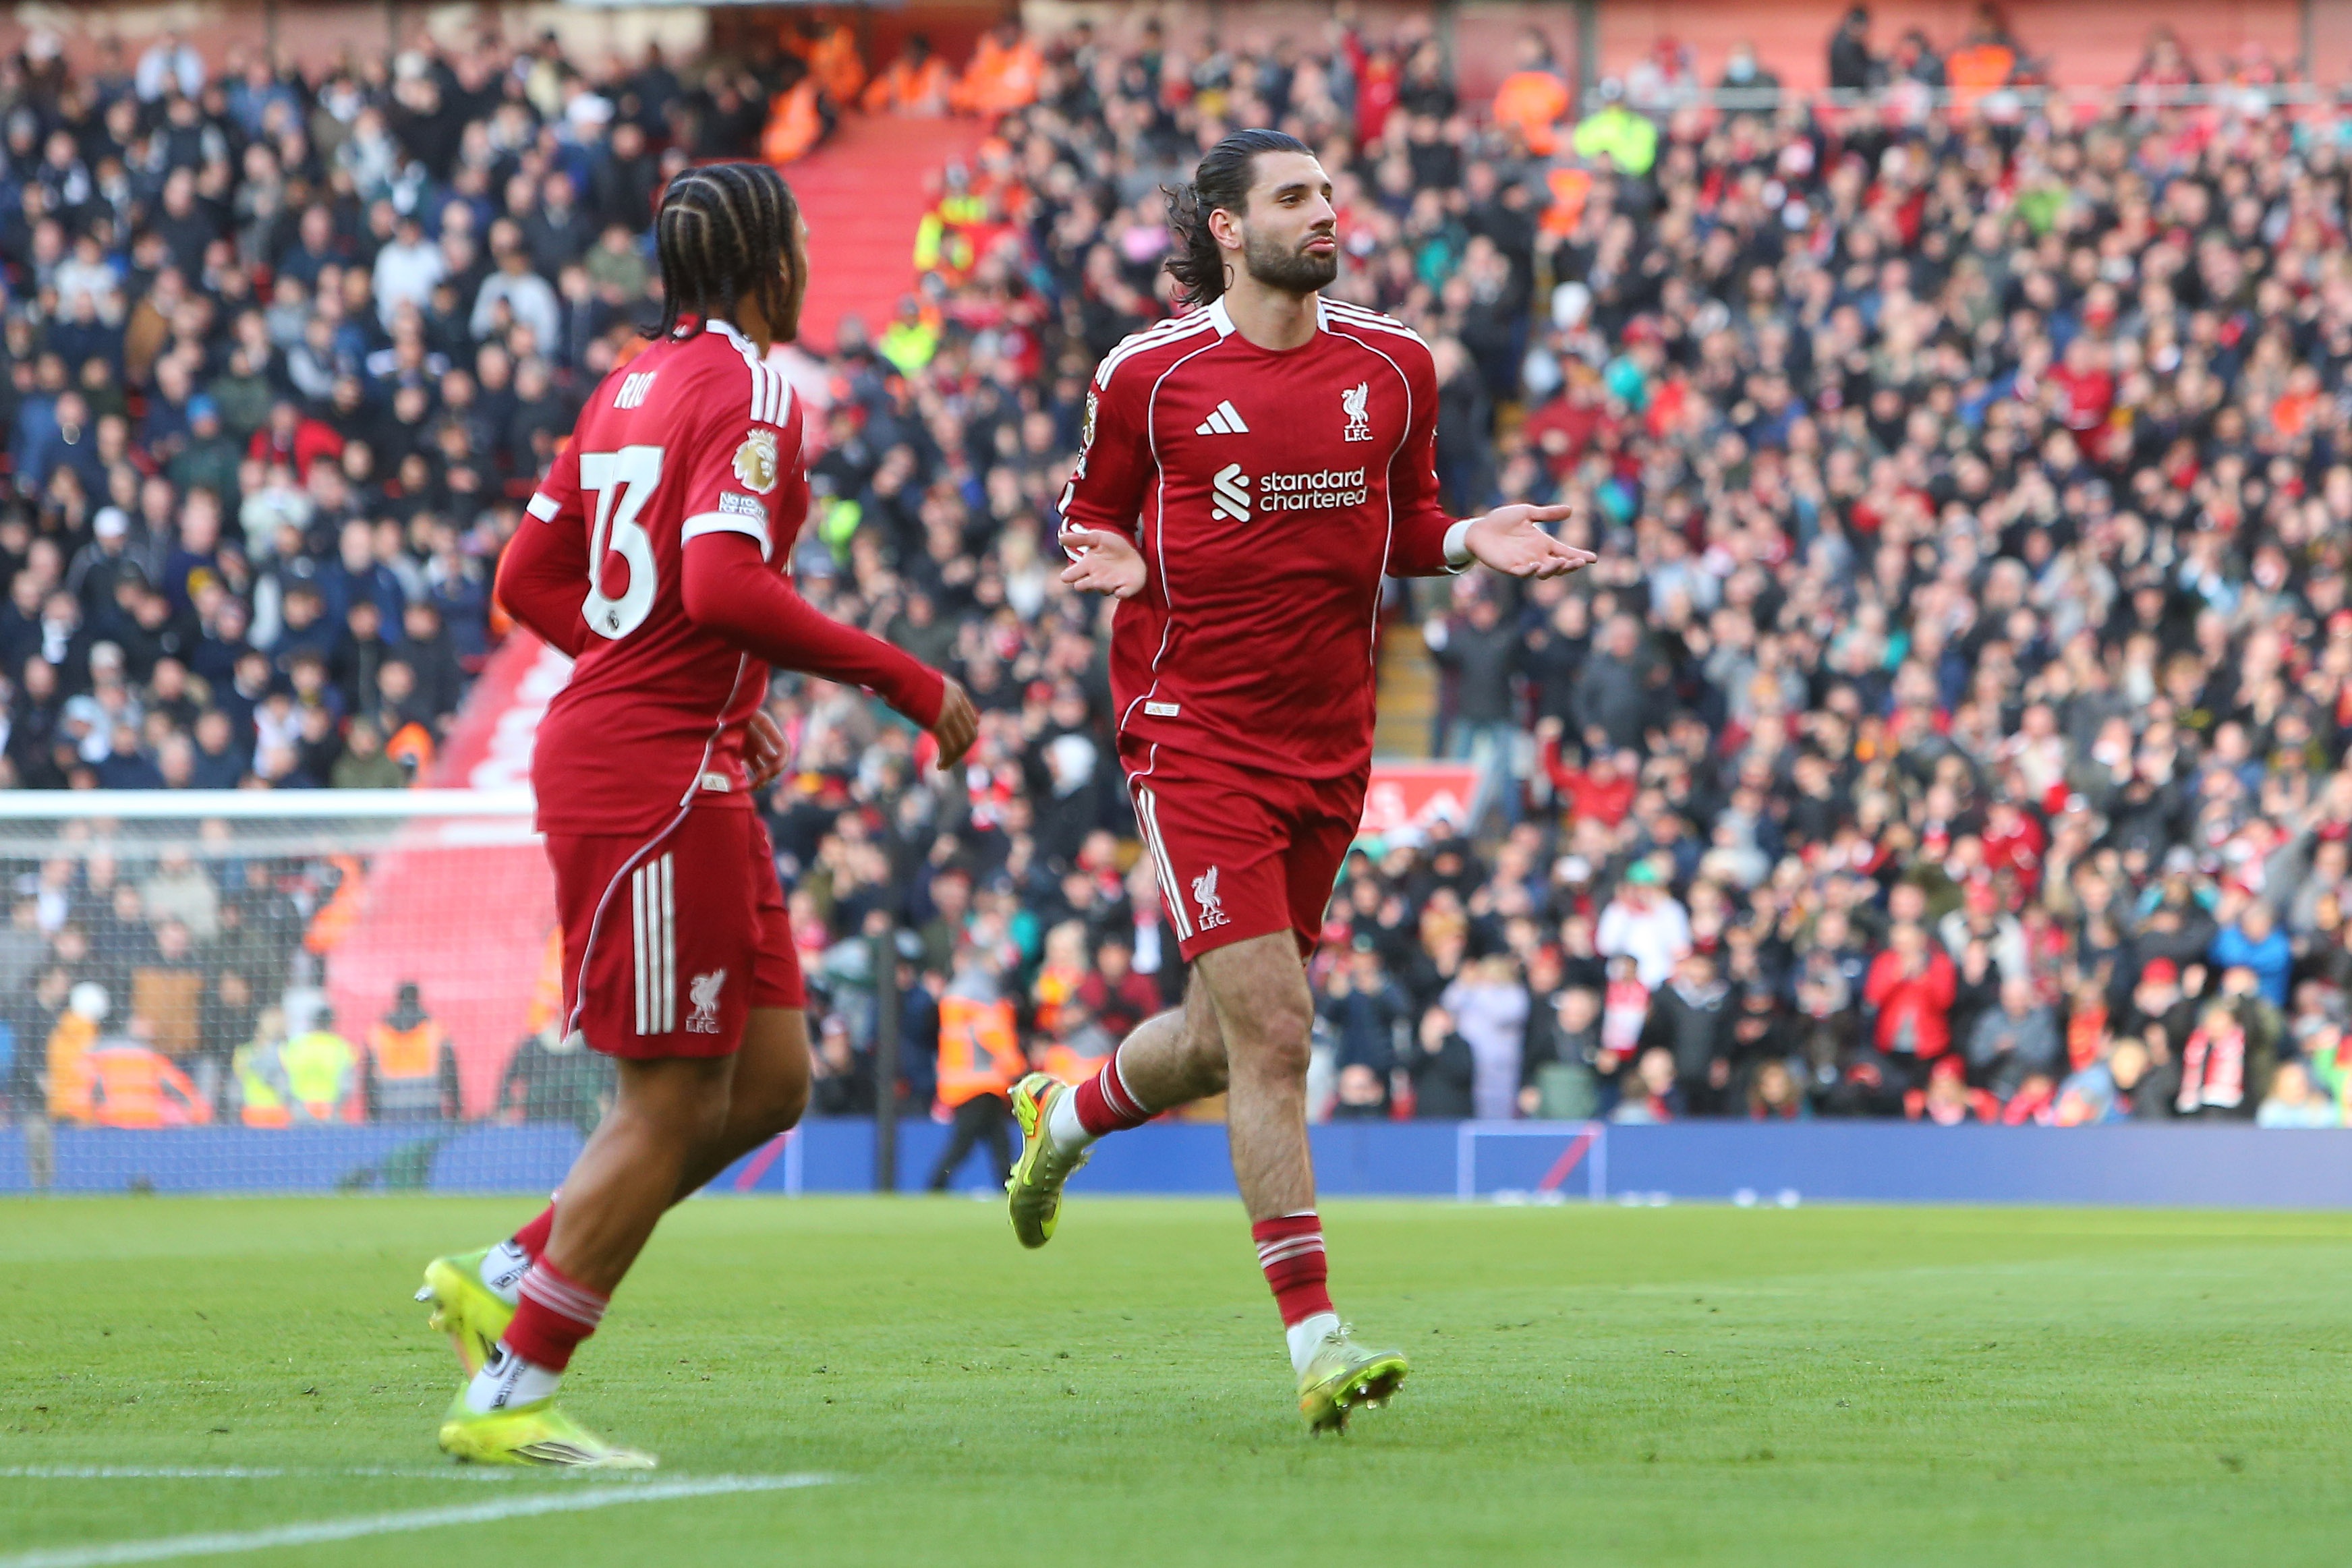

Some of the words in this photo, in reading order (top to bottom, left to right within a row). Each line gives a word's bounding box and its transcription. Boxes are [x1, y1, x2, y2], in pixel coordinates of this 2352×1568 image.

[612, 371, 656, 409] RIO
[1344, 428, 1373, 442] L.F.C.
[1260, 467, 1365, 492] standard
[1260, 486, 1368, 511] chartered
[579, 444, 665, 640] 73
[1199, 913, 1231, 931] L.F.C.
